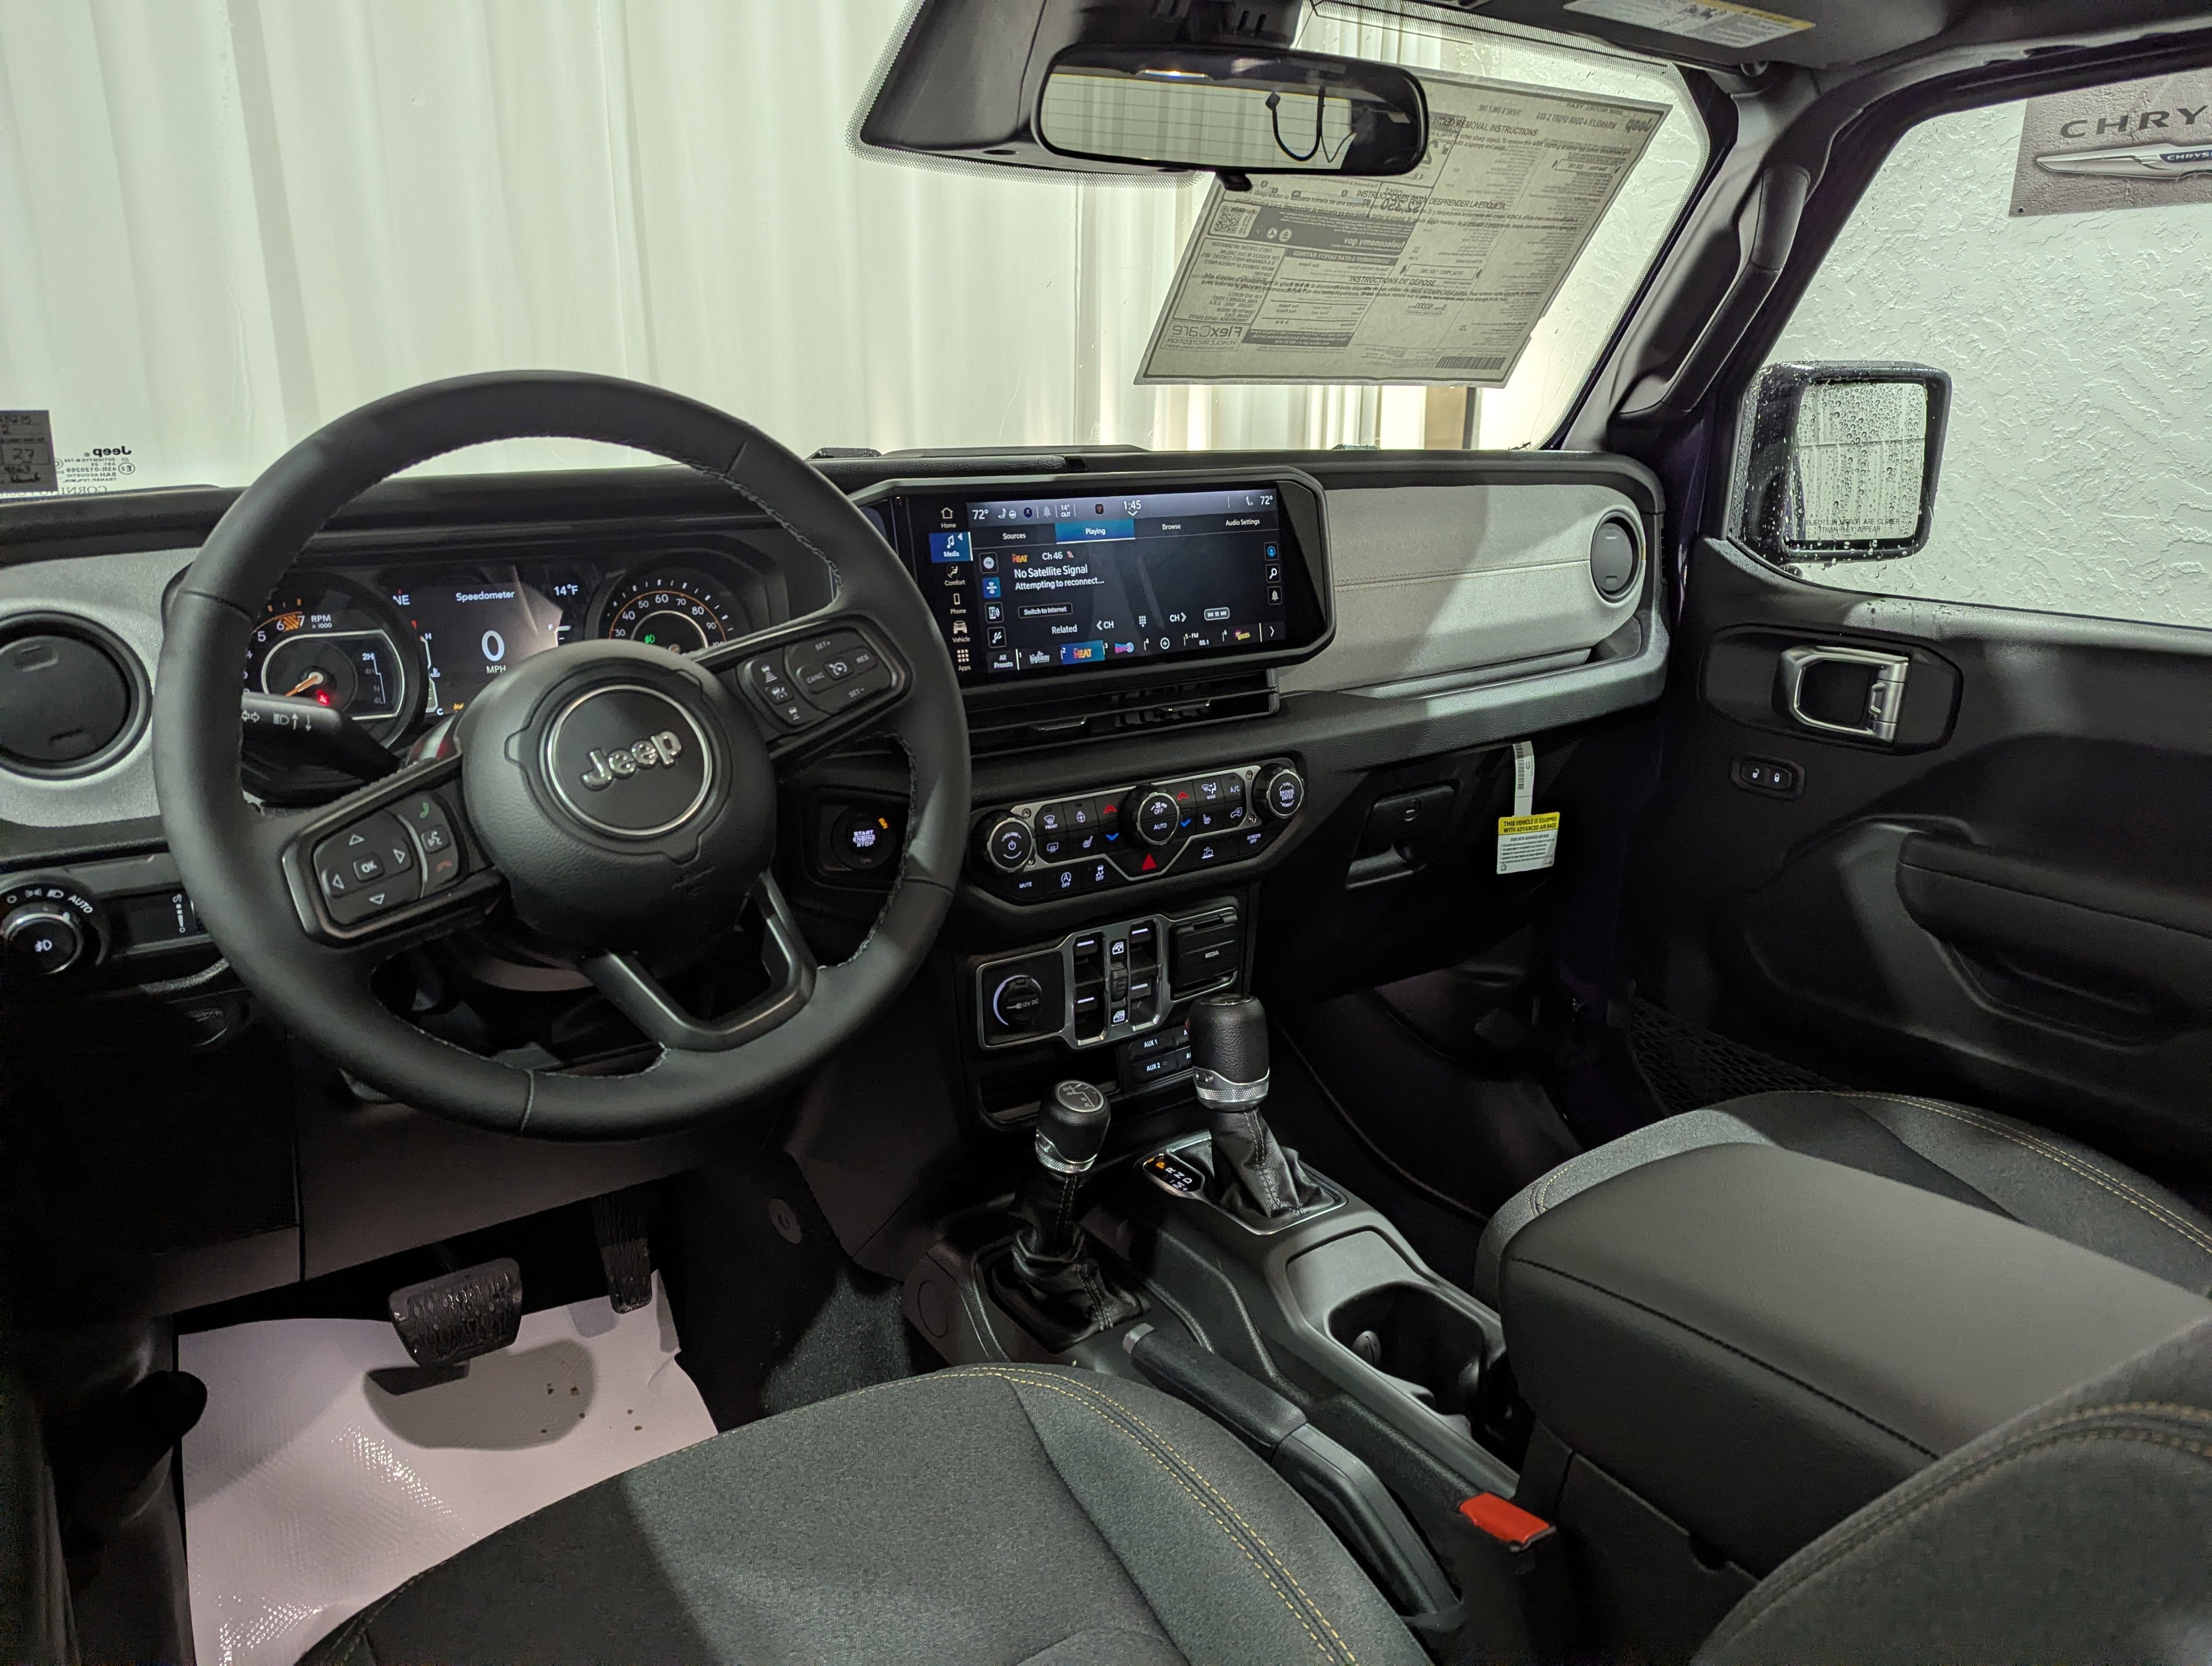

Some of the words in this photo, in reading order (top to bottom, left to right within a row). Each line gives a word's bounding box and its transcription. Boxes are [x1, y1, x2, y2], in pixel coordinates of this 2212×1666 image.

[2060, 105, 2210, 139] CHRY
[1489, 124, 1539, 137] INSTRUCTIONS
[1428, 197, 1470, 208] DESPRENDER
[1477, 201, 1506, 209] ETIQUETA
[1349, 275, 1398, 284] INSTRUCTIONS
[1123, 499, 1141, 510] 1:45
[1240, 518, 1260, 527] Settings
[1085, 528, 1105, 536] Playing
[1012, 553, 1028, 563] HEAT
[1042, 552, 1052, 560] Ch
[1053, 552, 1063, 560] 46
[1014, 568, 1027, 579] No
[1028, 566, 1061, 578] Satellite
[1063, 565, 1088, 576] Signal
[1015, 580, 1055, 591] Attempting
[455, 589, 515, 601] Speedometer
[654, 594, 668, 604] 60
[638, 599, 649, 608] 50
[676, 598, 686, 606] 70
[622, 611, 635, 620] 40
[692, 606, 704, 616] 80
[297, 615, 305, 627] 7
[311, 614, 331, 623] RPM
[1169, 614, 1180, 622] CH
[276, 620, 285, 631] 6
[706, 621, 716, 630] 90
[1052, 624, 1077, 635] Related
[1103, 621, 1114, 630] CH
[258, 630, 267, 642] 5
[615, 628, 626, 637] 30
[481, 630, 505, 662] 0
[362, 652, 375, 661] 2H
[1073, 648, 1092, 659] HEAT
[486, 665, 506, 674] MPH
[436, 707, 443, 715] C
[580, 730, 683, 790] Jeep
[1230, 785, 1240, 793] A/C
[1279, 788, 1294, 797] BROWSE
[1153, 822, 1167, 830] AUTO
[361, 860, 378, 873] OK
[67, 894, 93, 914] AUTO
[1205, 949, 1219, 959] MEDIA
[1144, 1039, 1155, 1049] AUX
[1146, 1062, 1157, 1072] AUX
[1172, 1181, 1185, 1189] M
